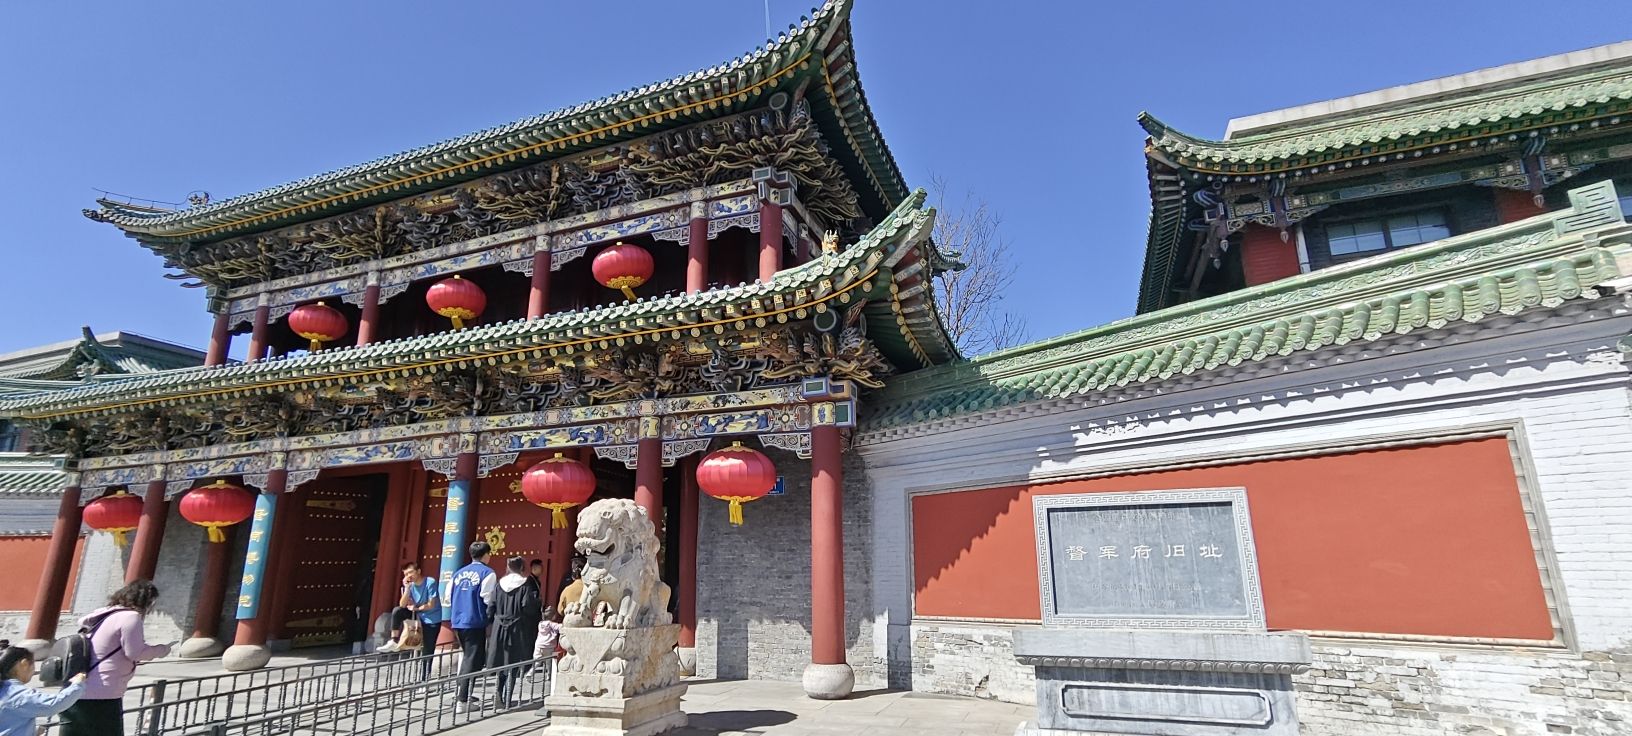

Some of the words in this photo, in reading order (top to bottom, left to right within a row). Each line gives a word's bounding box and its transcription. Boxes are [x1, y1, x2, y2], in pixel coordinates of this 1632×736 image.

[438, 495, 465, 604] 督军府旧
[1065, 544, 1223, 561] 督军府旧址
